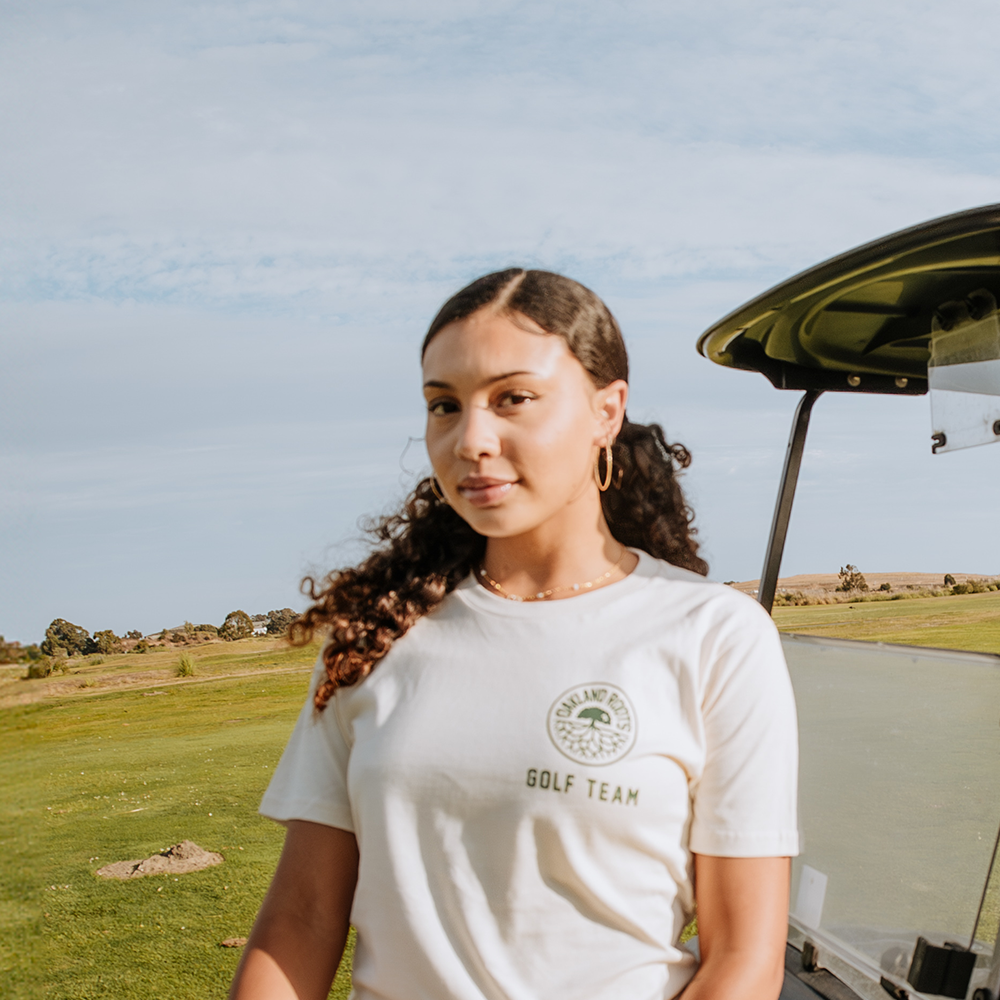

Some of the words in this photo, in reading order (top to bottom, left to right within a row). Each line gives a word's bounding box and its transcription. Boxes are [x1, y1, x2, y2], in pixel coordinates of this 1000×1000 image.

[555, 688, 608, 718] OAKLAND
[526, 768, 575, 793] GOLF
[587, 778, 640, 806] TEAM
